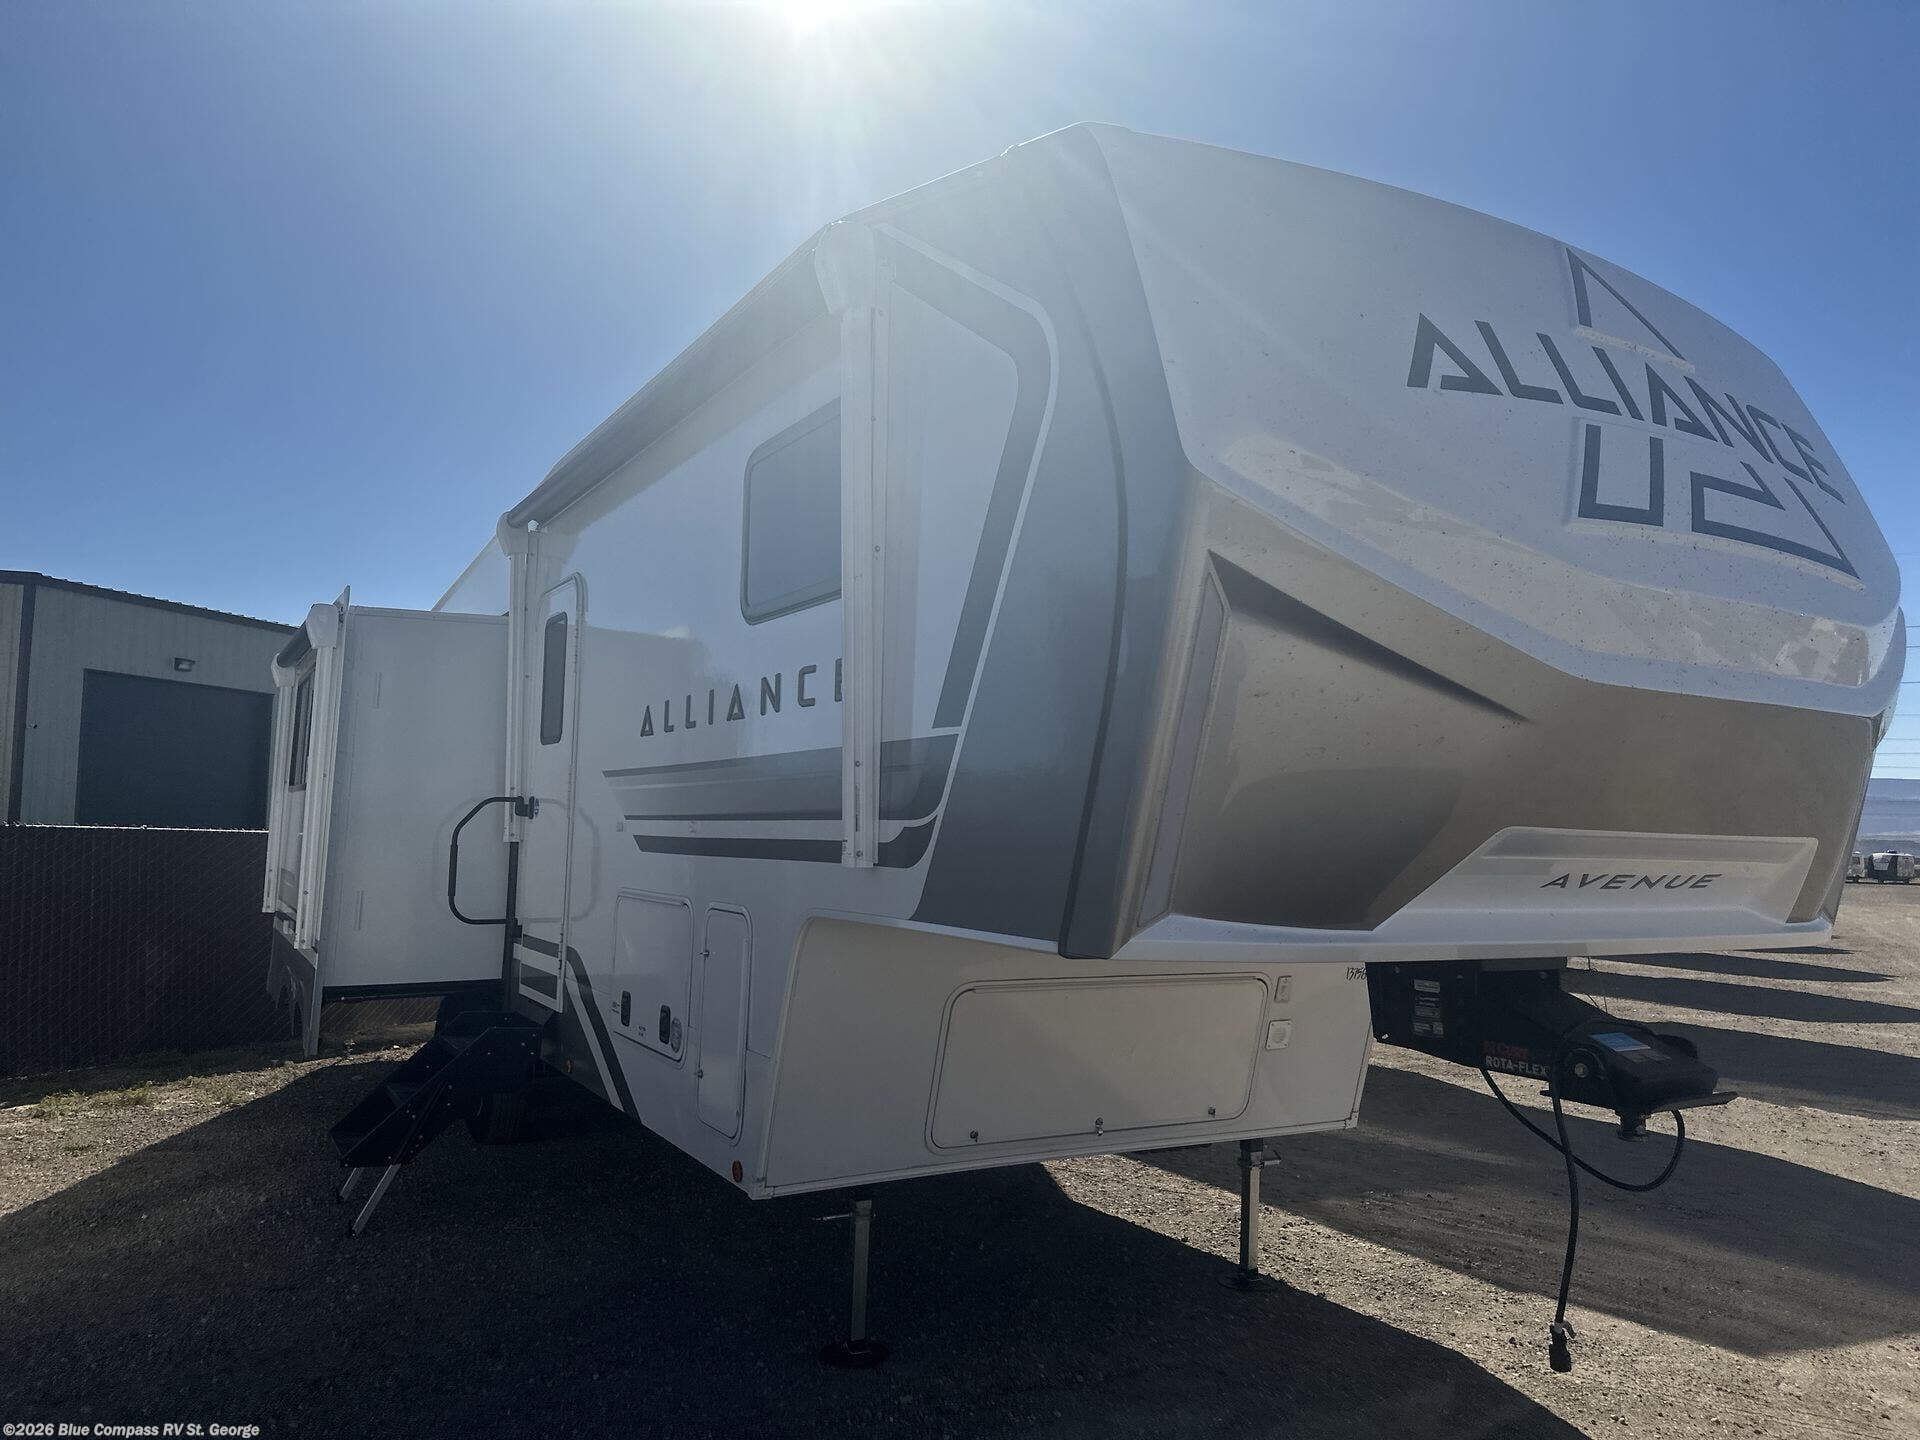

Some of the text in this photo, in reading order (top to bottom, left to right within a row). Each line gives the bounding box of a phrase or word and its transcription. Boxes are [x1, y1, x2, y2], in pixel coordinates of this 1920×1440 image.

[1407, 313, 1845, 504] ALLIANCE
[1540, 873, 1723, 890] AVENUE
[1485, 1055, 1550, 1076] ROTA-FLEX
